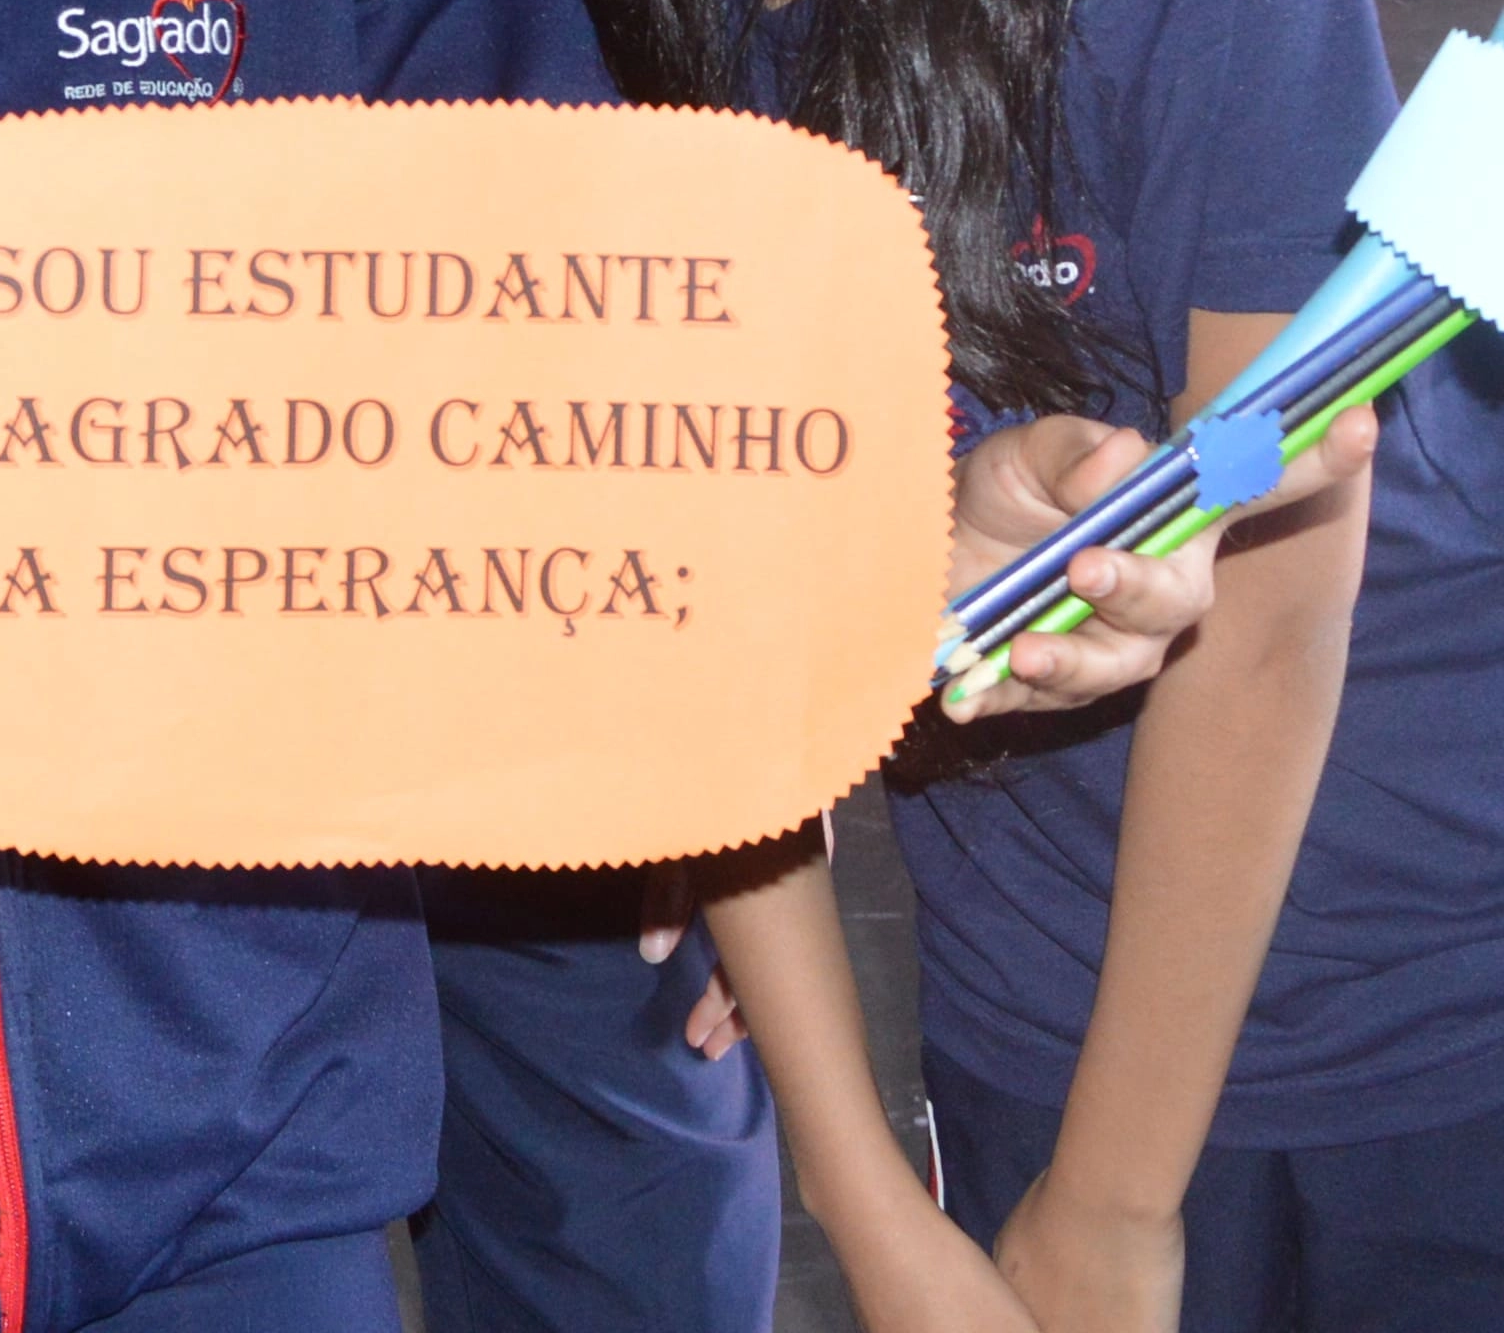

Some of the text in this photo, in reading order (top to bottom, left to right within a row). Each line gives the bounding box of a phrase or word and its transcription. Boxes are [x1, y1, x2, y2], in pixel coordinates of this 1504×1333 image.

[57, 2, 232, 67] Sagrado
[64, 77, 214, 102] REDE DE EDUCAÇÃO
[185, 249, 734, 324] ESTUDANTE
[428, 398, 850, 475] CAMINHO
[95, 546, 691, 638] ESPERANÇA;
